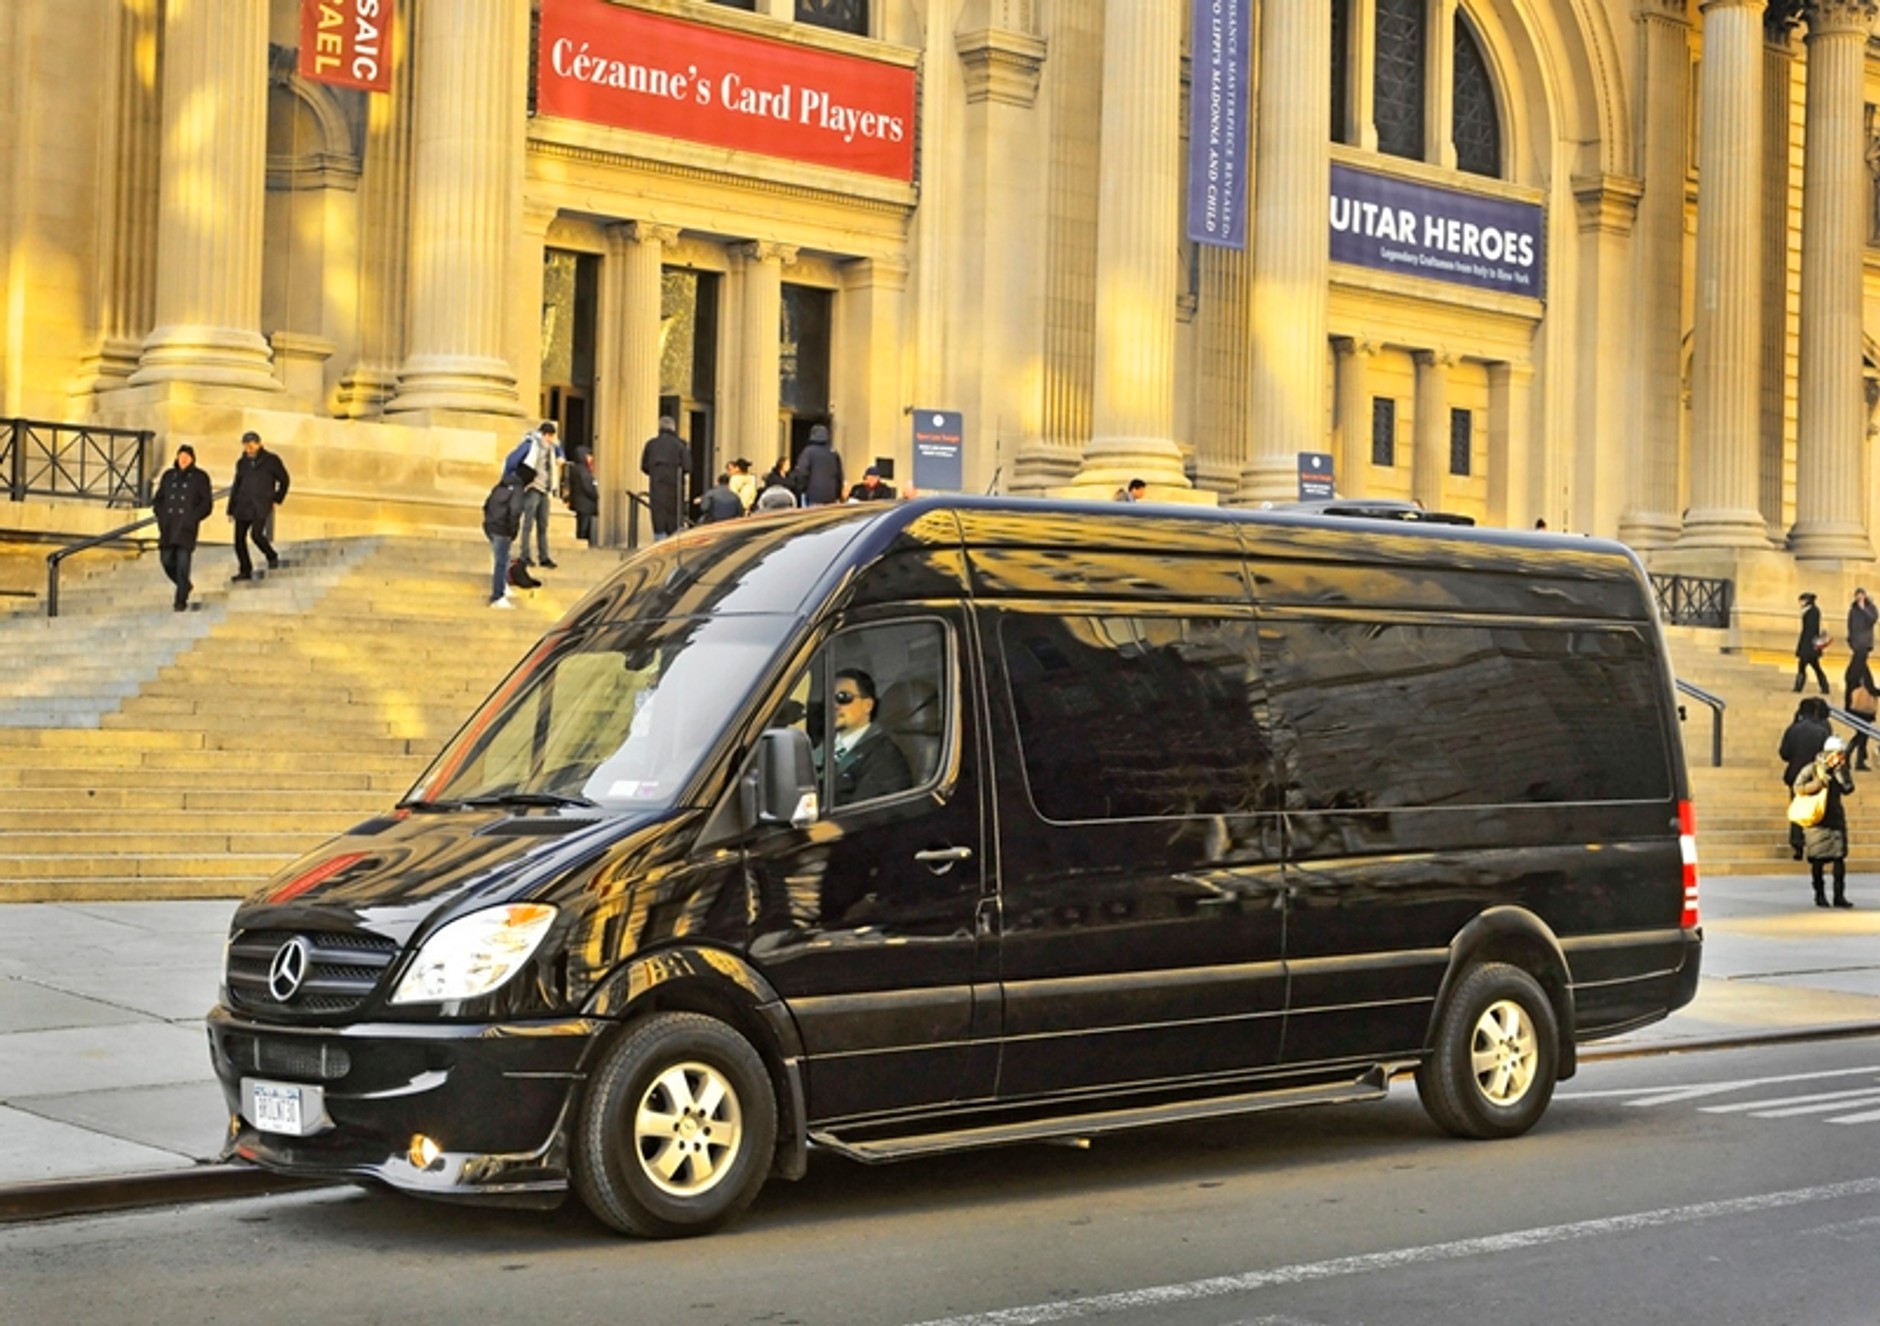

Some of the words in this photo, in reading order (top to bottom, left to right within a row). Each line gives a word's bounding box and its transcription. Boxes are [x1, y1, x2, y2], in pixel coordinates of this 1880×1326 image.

[315, 0, 344, 74] AEL
[352, 0, 379, 81] SAIC
[552, 37, 711, 105] Cézanne’s
[720, 72, 791, 121] Card
[799, 88, 904, 143] Players
[1210, 67, 1221, 145] MADONNA
[1208, 147, 1219, 182] AND
[1206, 184, 1218, 232] CHILD
[1329, 195, 1417, 245] UITAR
[1423, 214, 1534, 267] HEROES
